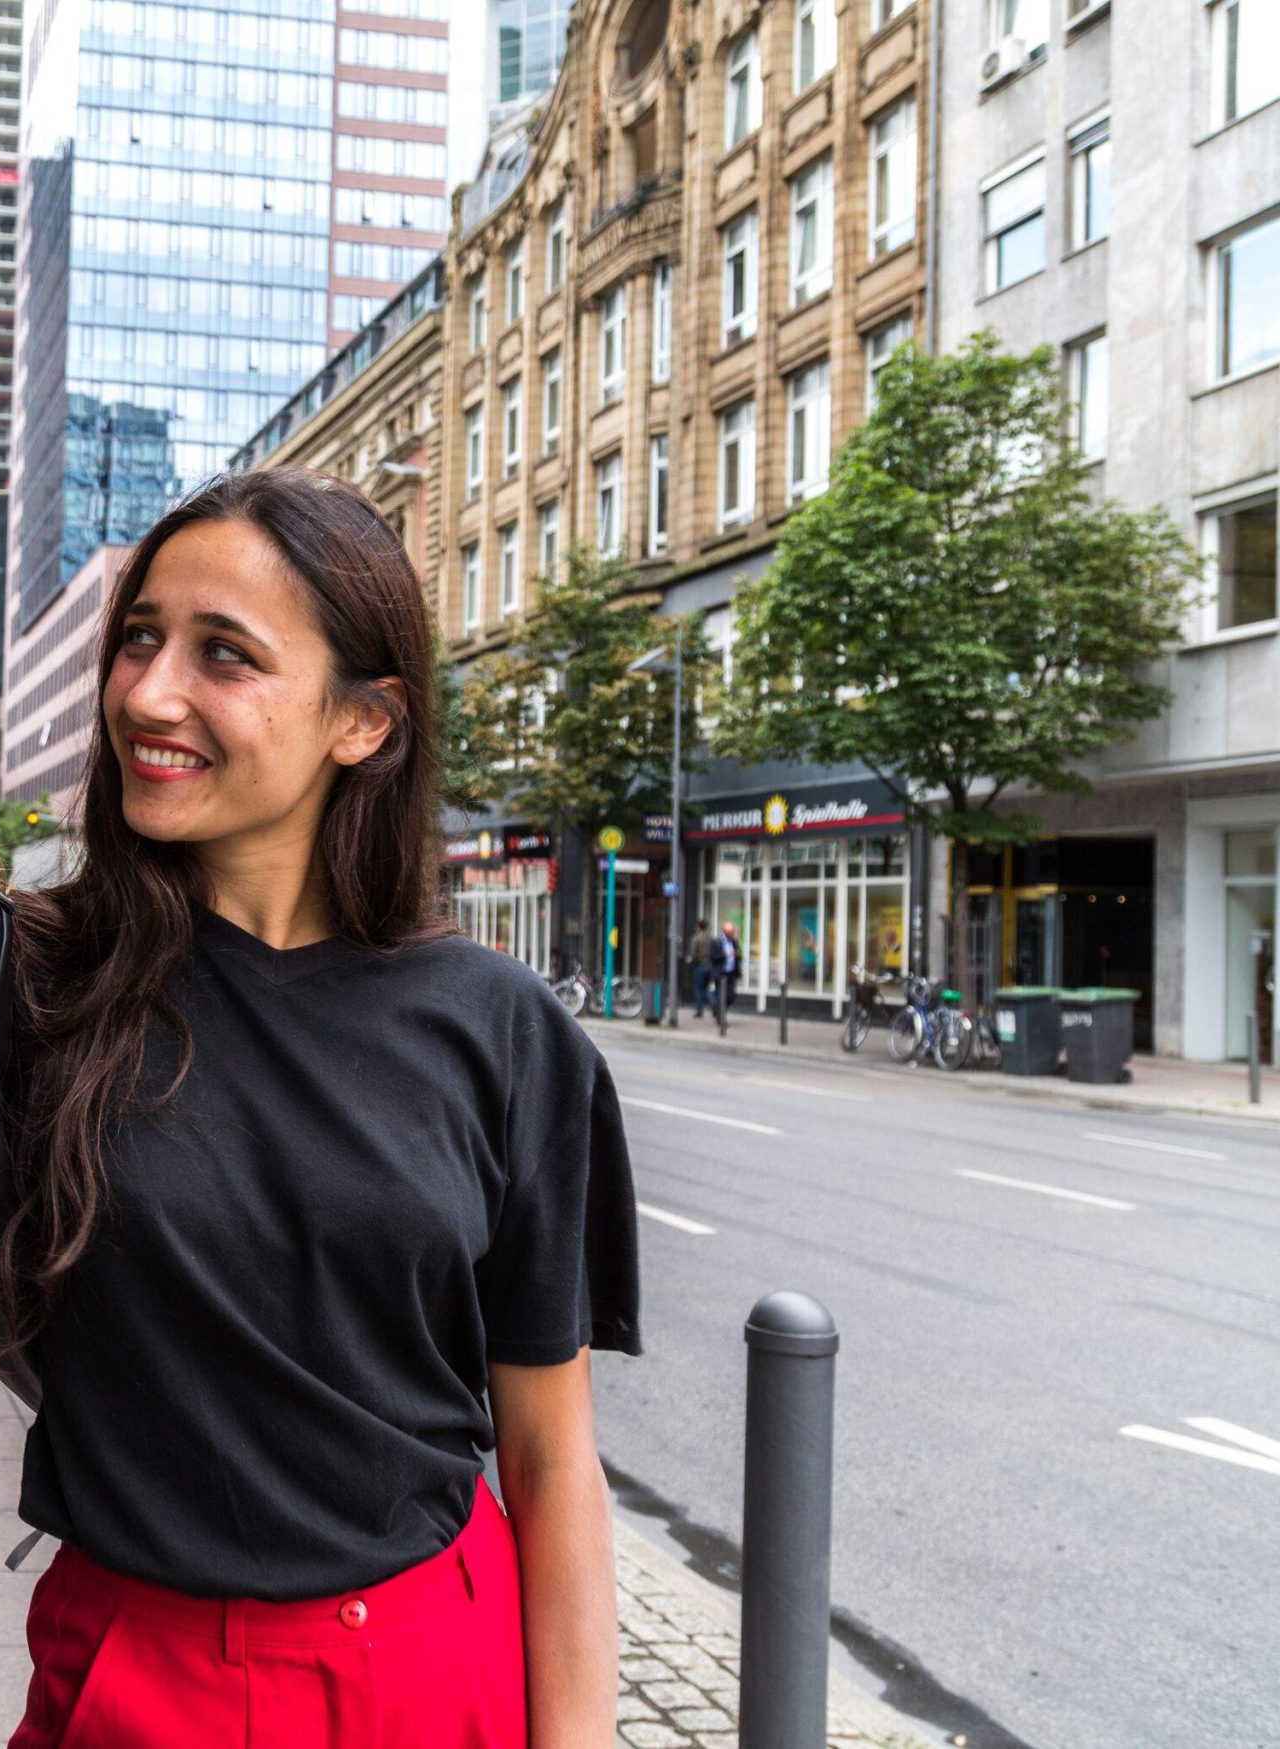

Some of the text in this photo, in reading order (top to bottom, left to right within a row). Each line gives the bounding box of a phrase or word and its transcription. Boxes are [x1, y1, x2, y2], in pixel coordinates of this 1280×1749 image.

[646, 815, 673, 827] HOTE
[702, 798, 868, 831] MERKUR Spielhalle
